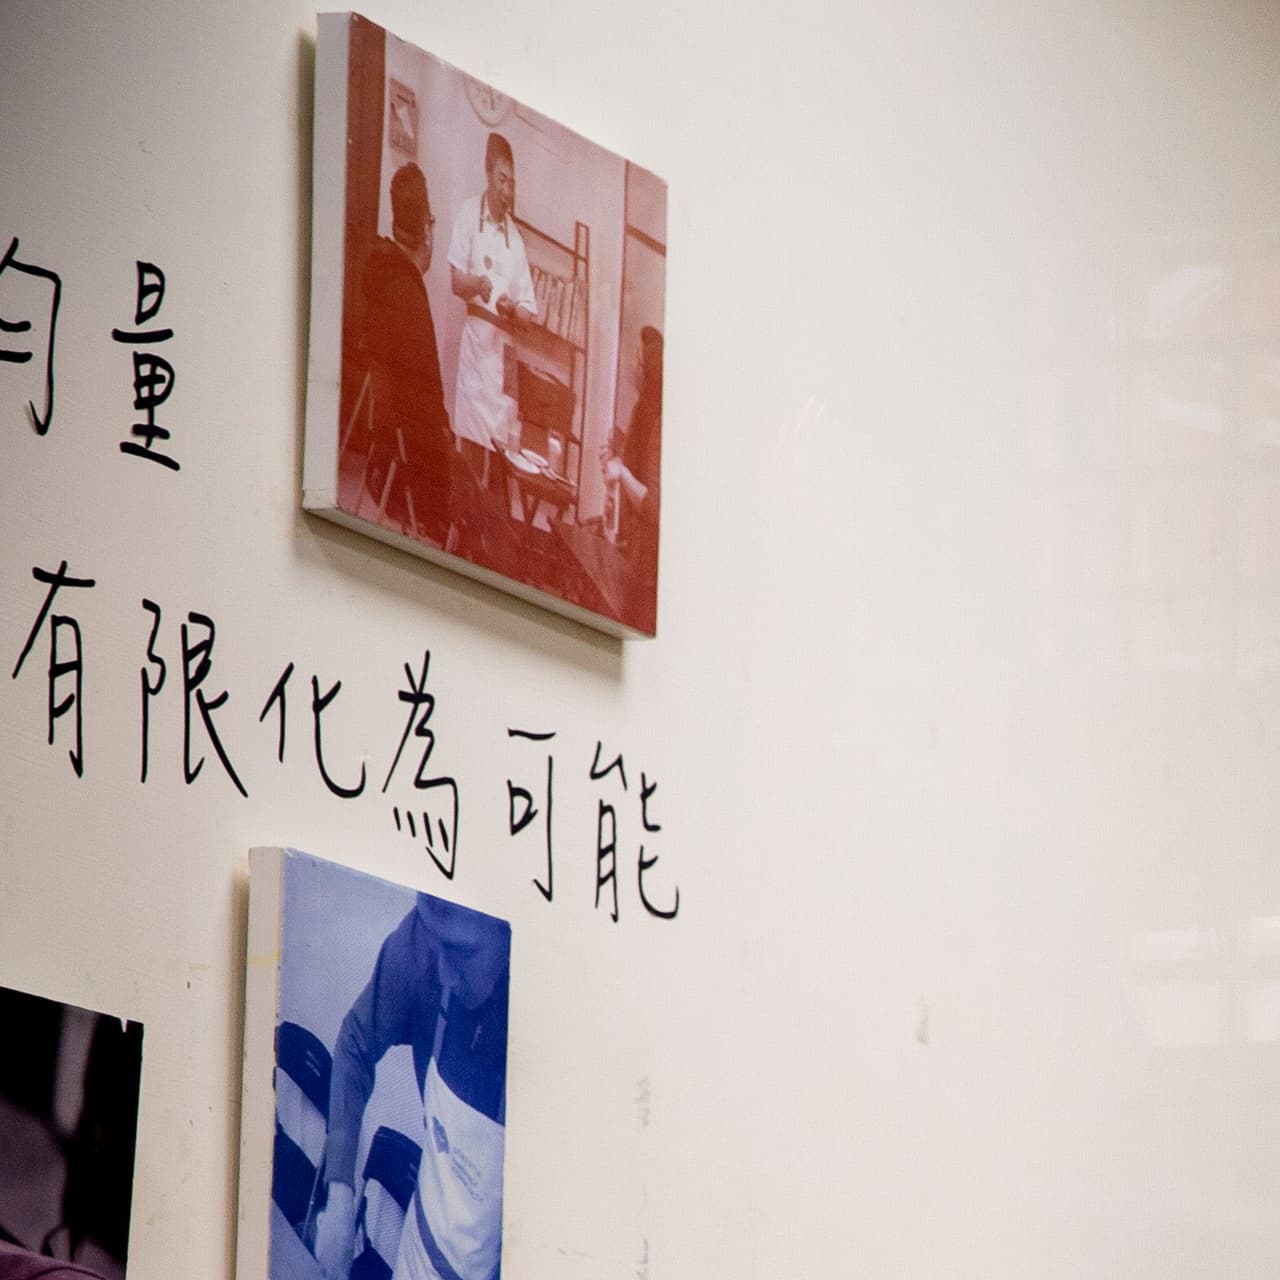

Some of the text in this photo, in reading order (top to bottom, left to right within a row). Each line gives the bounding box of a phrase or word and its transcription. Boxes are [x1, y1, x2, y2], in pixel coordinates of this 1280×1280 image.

[13, 560, 679, 922] 有限化為可能
